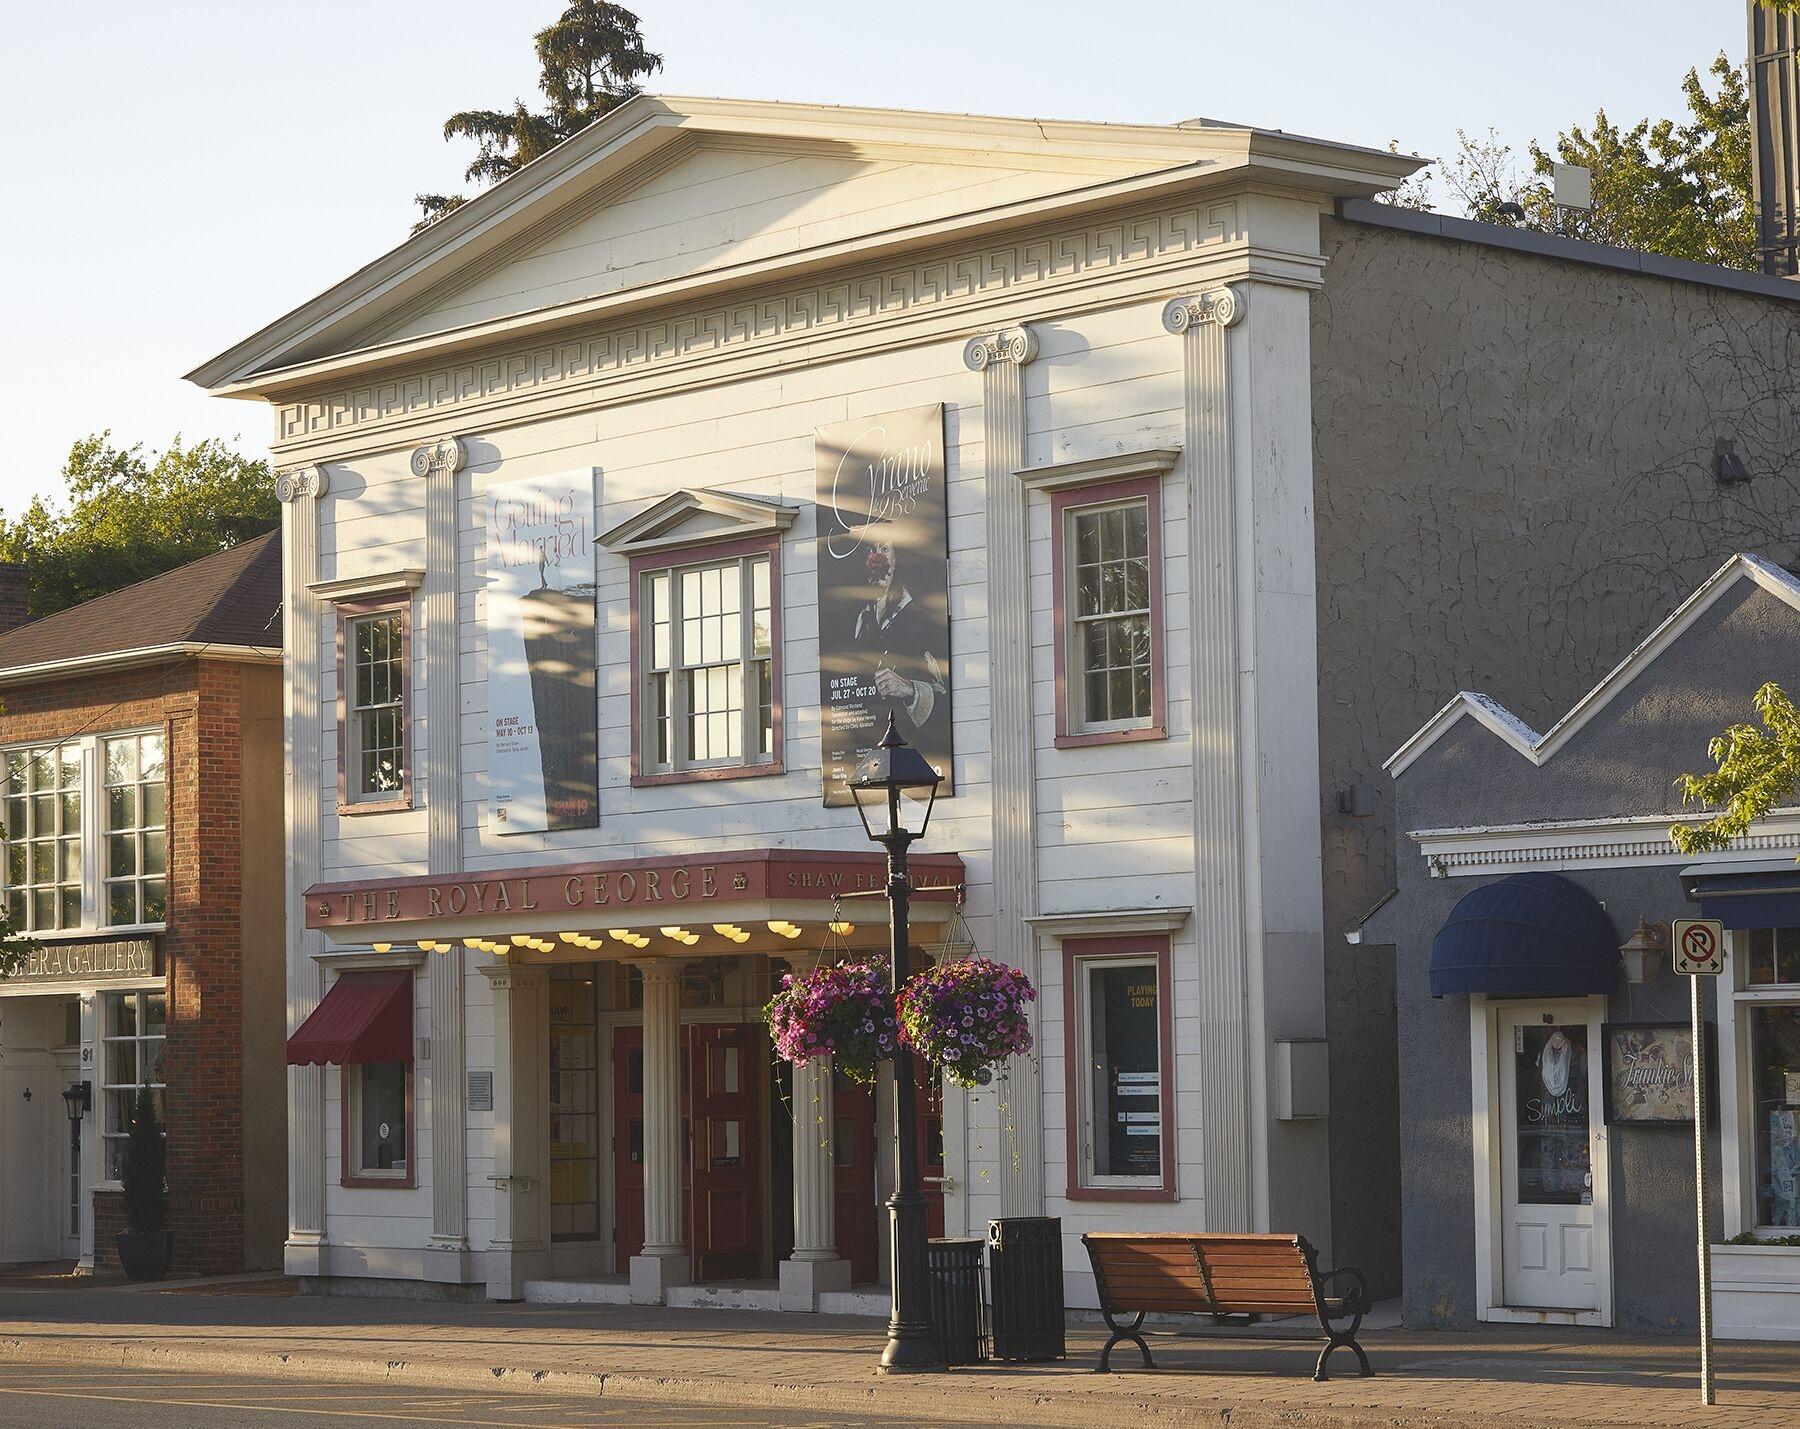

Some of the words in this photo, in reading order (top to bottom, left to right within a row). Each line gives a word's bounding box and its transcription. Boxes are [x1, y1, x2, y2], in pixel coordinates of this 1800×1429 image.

[831, 679, 838, 688] ON
[840, 677, 857, 687] STAGE
[831, 690, 842, 700] JUL
[843, 689, 850, 698] 27
[856, 687, 867, 697] OCT
[868, 686, 876, 695] 20
[496, 719, 503, 727] ON
[504, 717, 519, 726] STAGE
[496, 728, 506, 738] MAY
[507, 727, 513, 736] 10
[517, 726, 527, 736] OCT
[528, 725, 534, 734] 13
[554, 800, 577, 809] SHAW
[787, 872, 843, 888] SHAW
[855, 873, 953, 889] FEIVAL
[341, 890, 401, 922] THE
[428, 880, 538, 917] ROYAL
[564, 866, 718, 907] GEORGE
[67, 941, 149, 974] GALLERY
[1127, 985, 1157, 996] PLAYING
[1131, 997, 1154, 1008] TODAY
[82, 1048, 93, 1061] 91
[1621, 1054, 1675, 1089] Frankie
